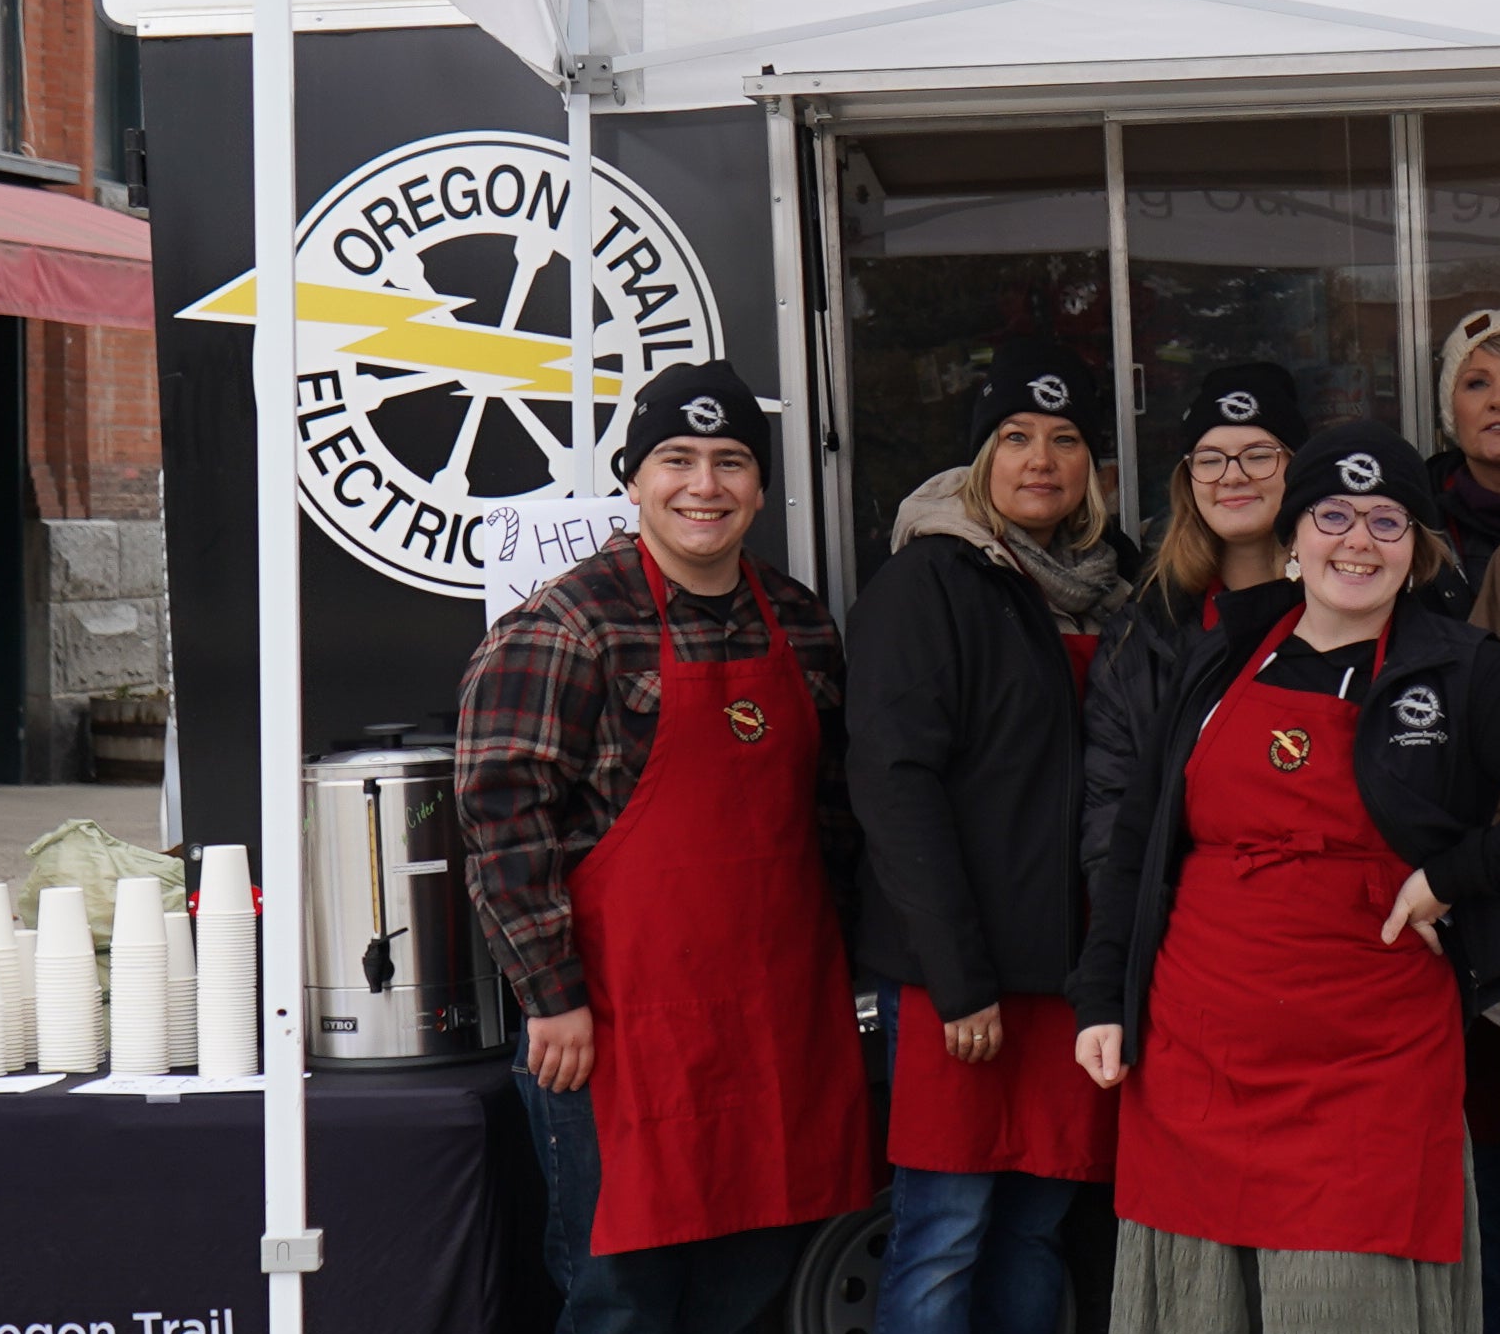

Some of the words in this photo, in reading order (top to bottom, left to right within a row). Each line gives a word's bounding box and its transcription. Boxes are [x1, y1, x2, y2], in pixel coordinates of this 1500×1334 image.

[332, 164, 571, 277] OREGON
[593, 205, 694, 373] TRAIL
[406, 800, 436, 829] Cider
[323, 1019, 354, 1031] SYBO
